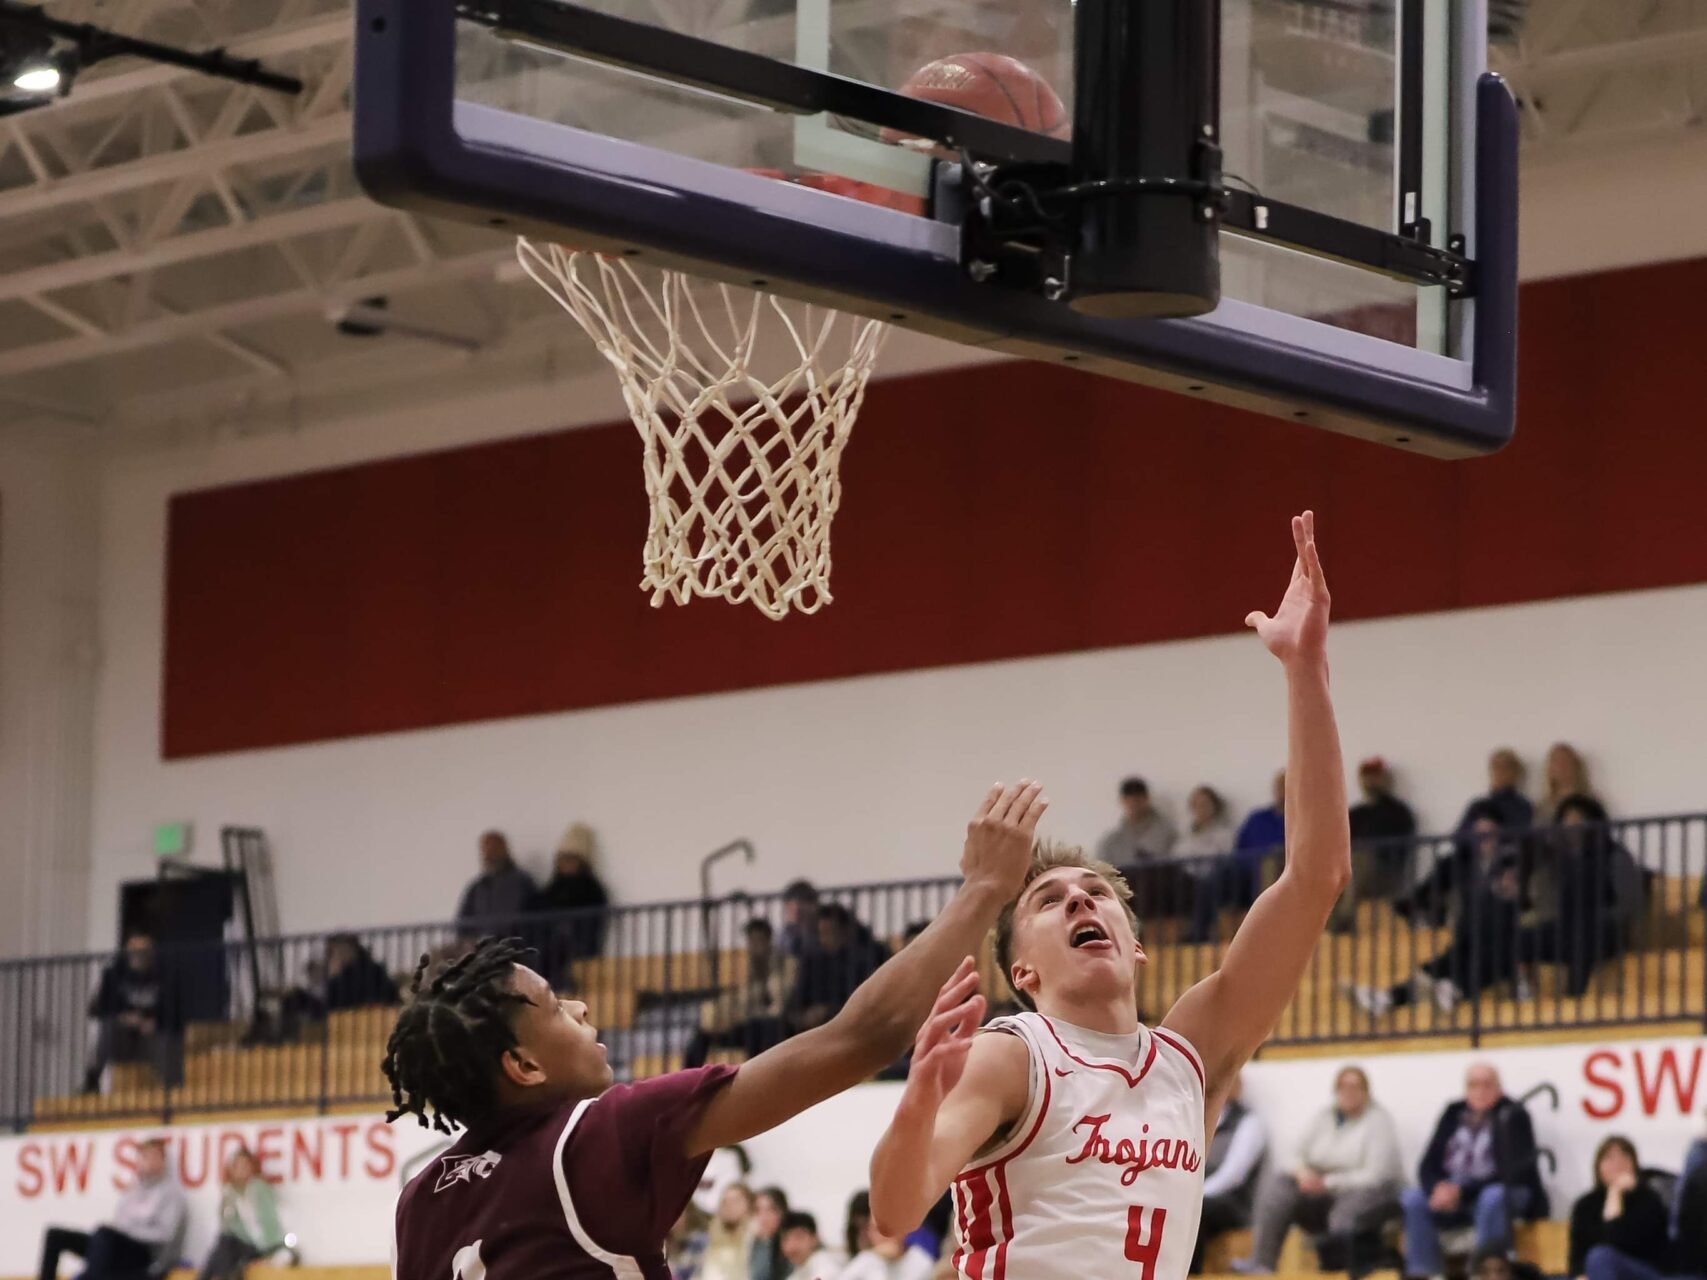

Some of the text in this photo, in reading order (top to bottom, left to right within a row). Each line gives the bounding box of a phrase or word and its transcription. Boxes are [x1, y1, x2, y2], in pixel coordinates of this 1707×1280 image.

[1581, 1047, 1703, 1119] SW
[16, 1122, 397, 1197] SW SUDENTS
